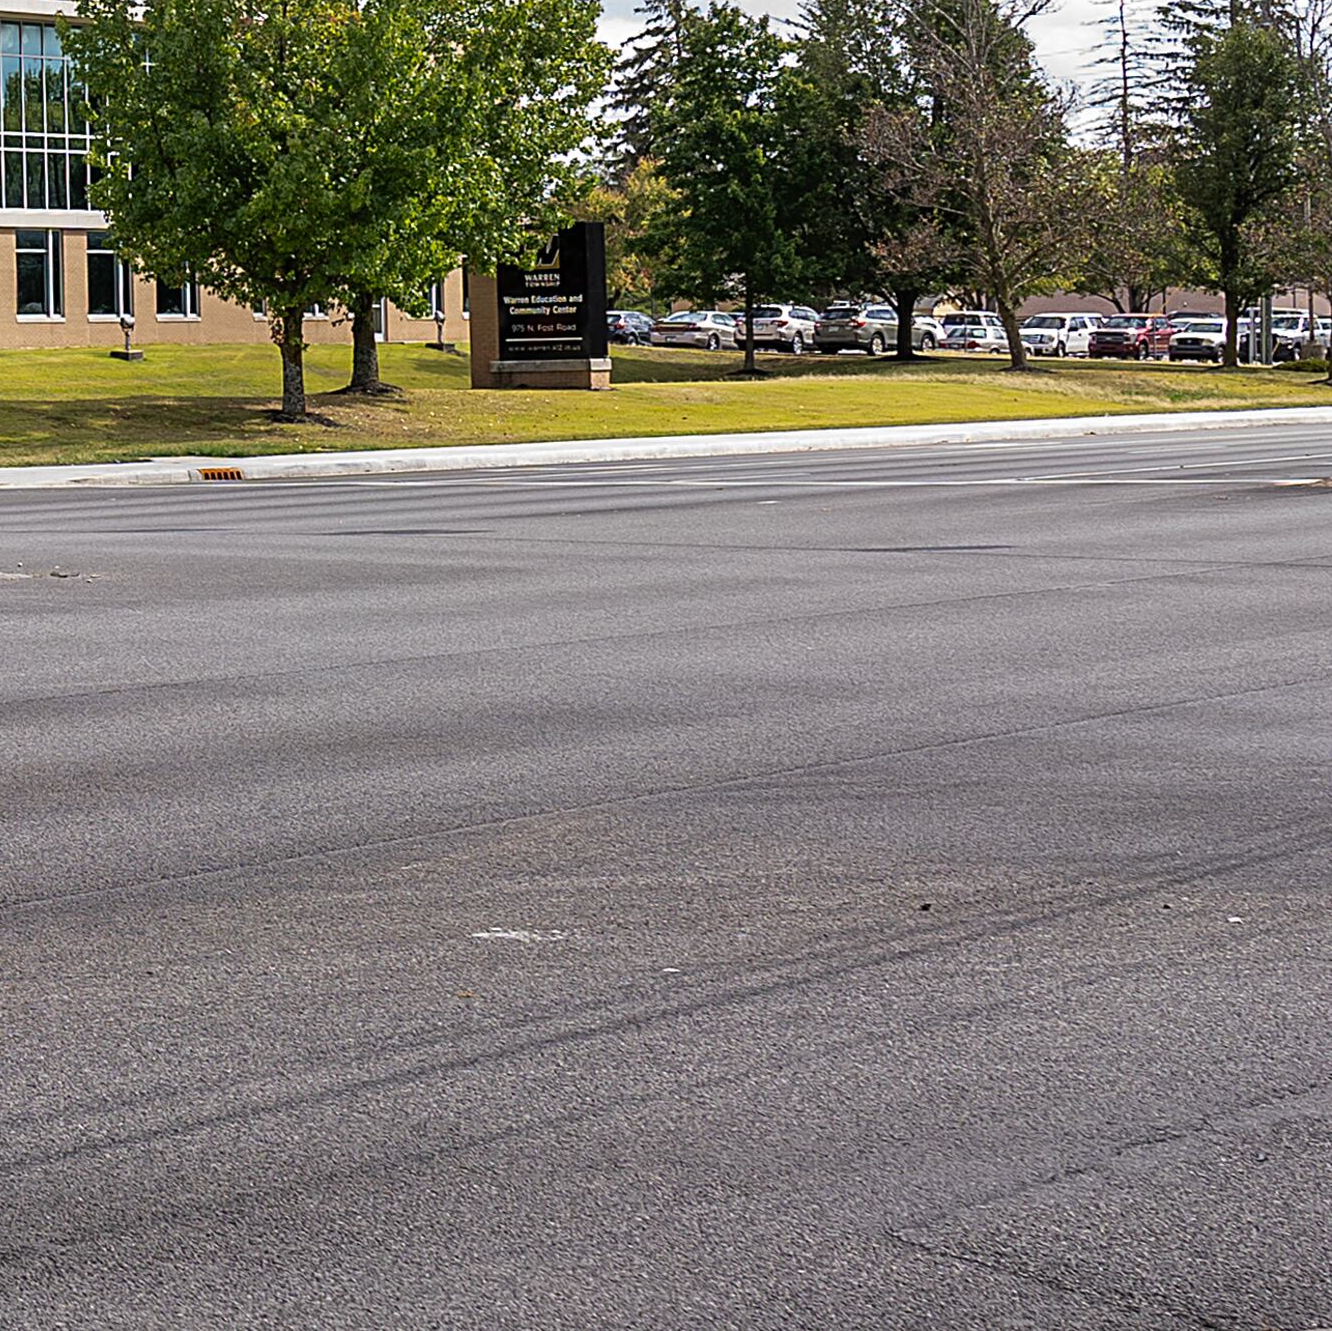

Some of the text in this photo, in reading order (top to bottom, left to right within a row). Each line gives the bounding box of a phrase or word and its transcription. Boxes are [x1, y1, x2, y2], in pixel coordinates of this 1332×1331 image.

[524, 273, 560, 281] WARREN
[531, 295, 567, 304] Education
[569, 294, 583, 303] and
[509, 305, 577, 316] Community Center
